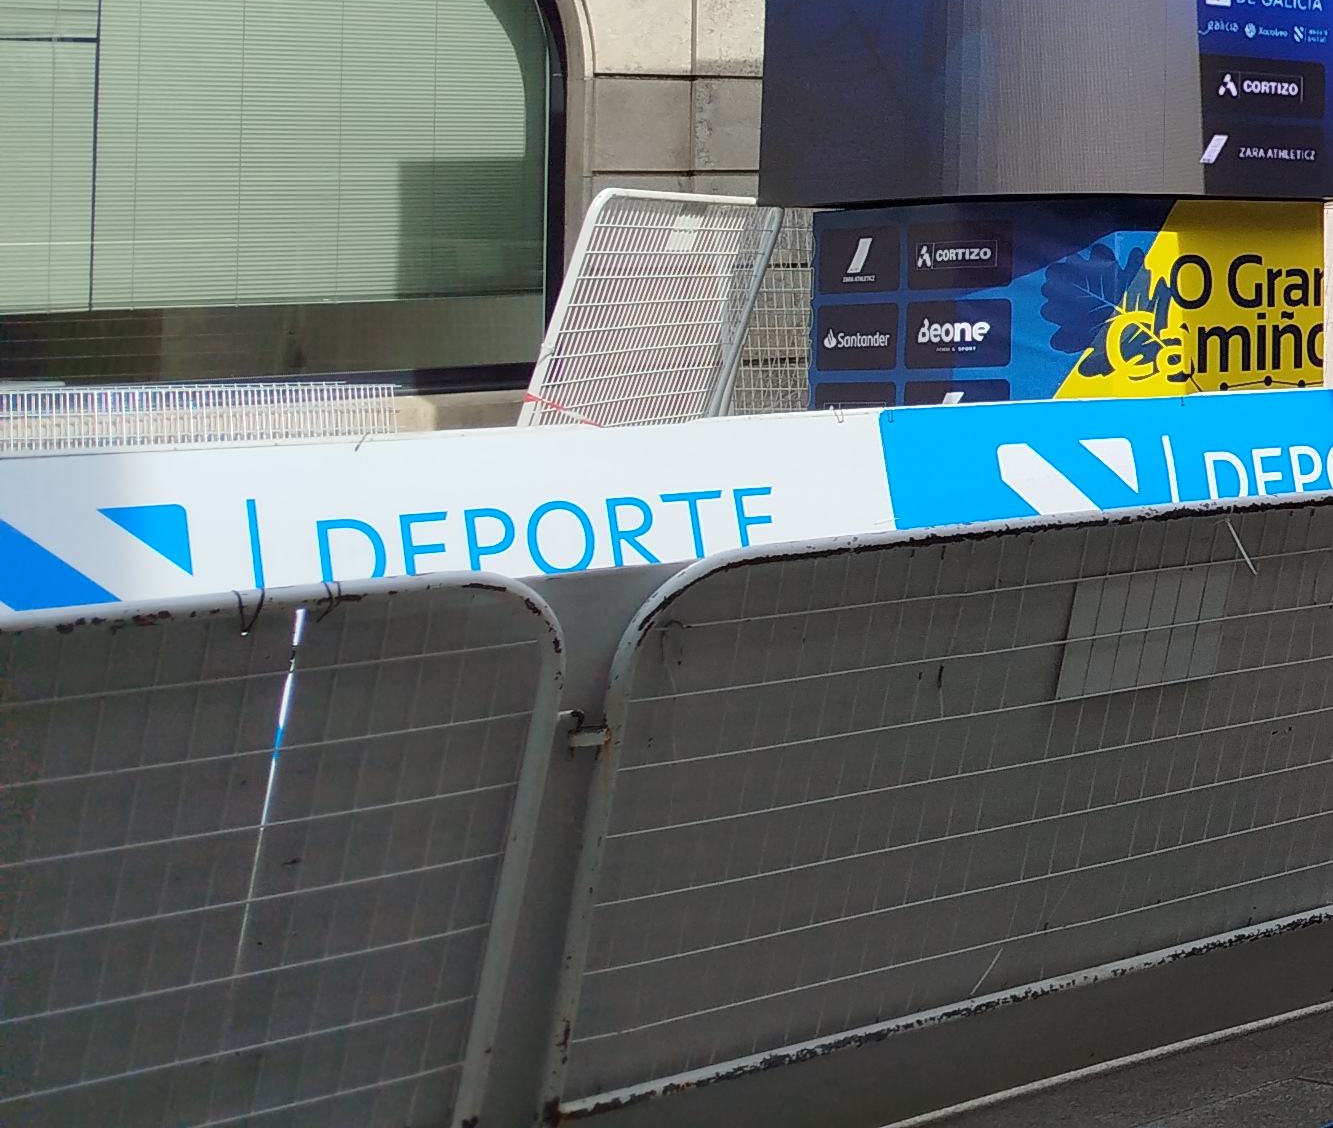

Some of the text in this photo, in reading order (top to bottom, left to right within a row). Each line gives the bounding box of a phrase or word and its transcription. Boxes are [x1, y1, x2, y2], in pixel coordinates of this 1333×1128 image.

[1243, 80, 1298, 96] CORTIZO
[1239, 147, 1265, 158] ZARA
[936, 248, 992, 261] CORTIZO
[1170, 254, 1212, 309] O
[918, 318, 991, 343] Beone
[838, 331, 890, 348] Santander
[316, 486, 772, 583] DEPORTE
